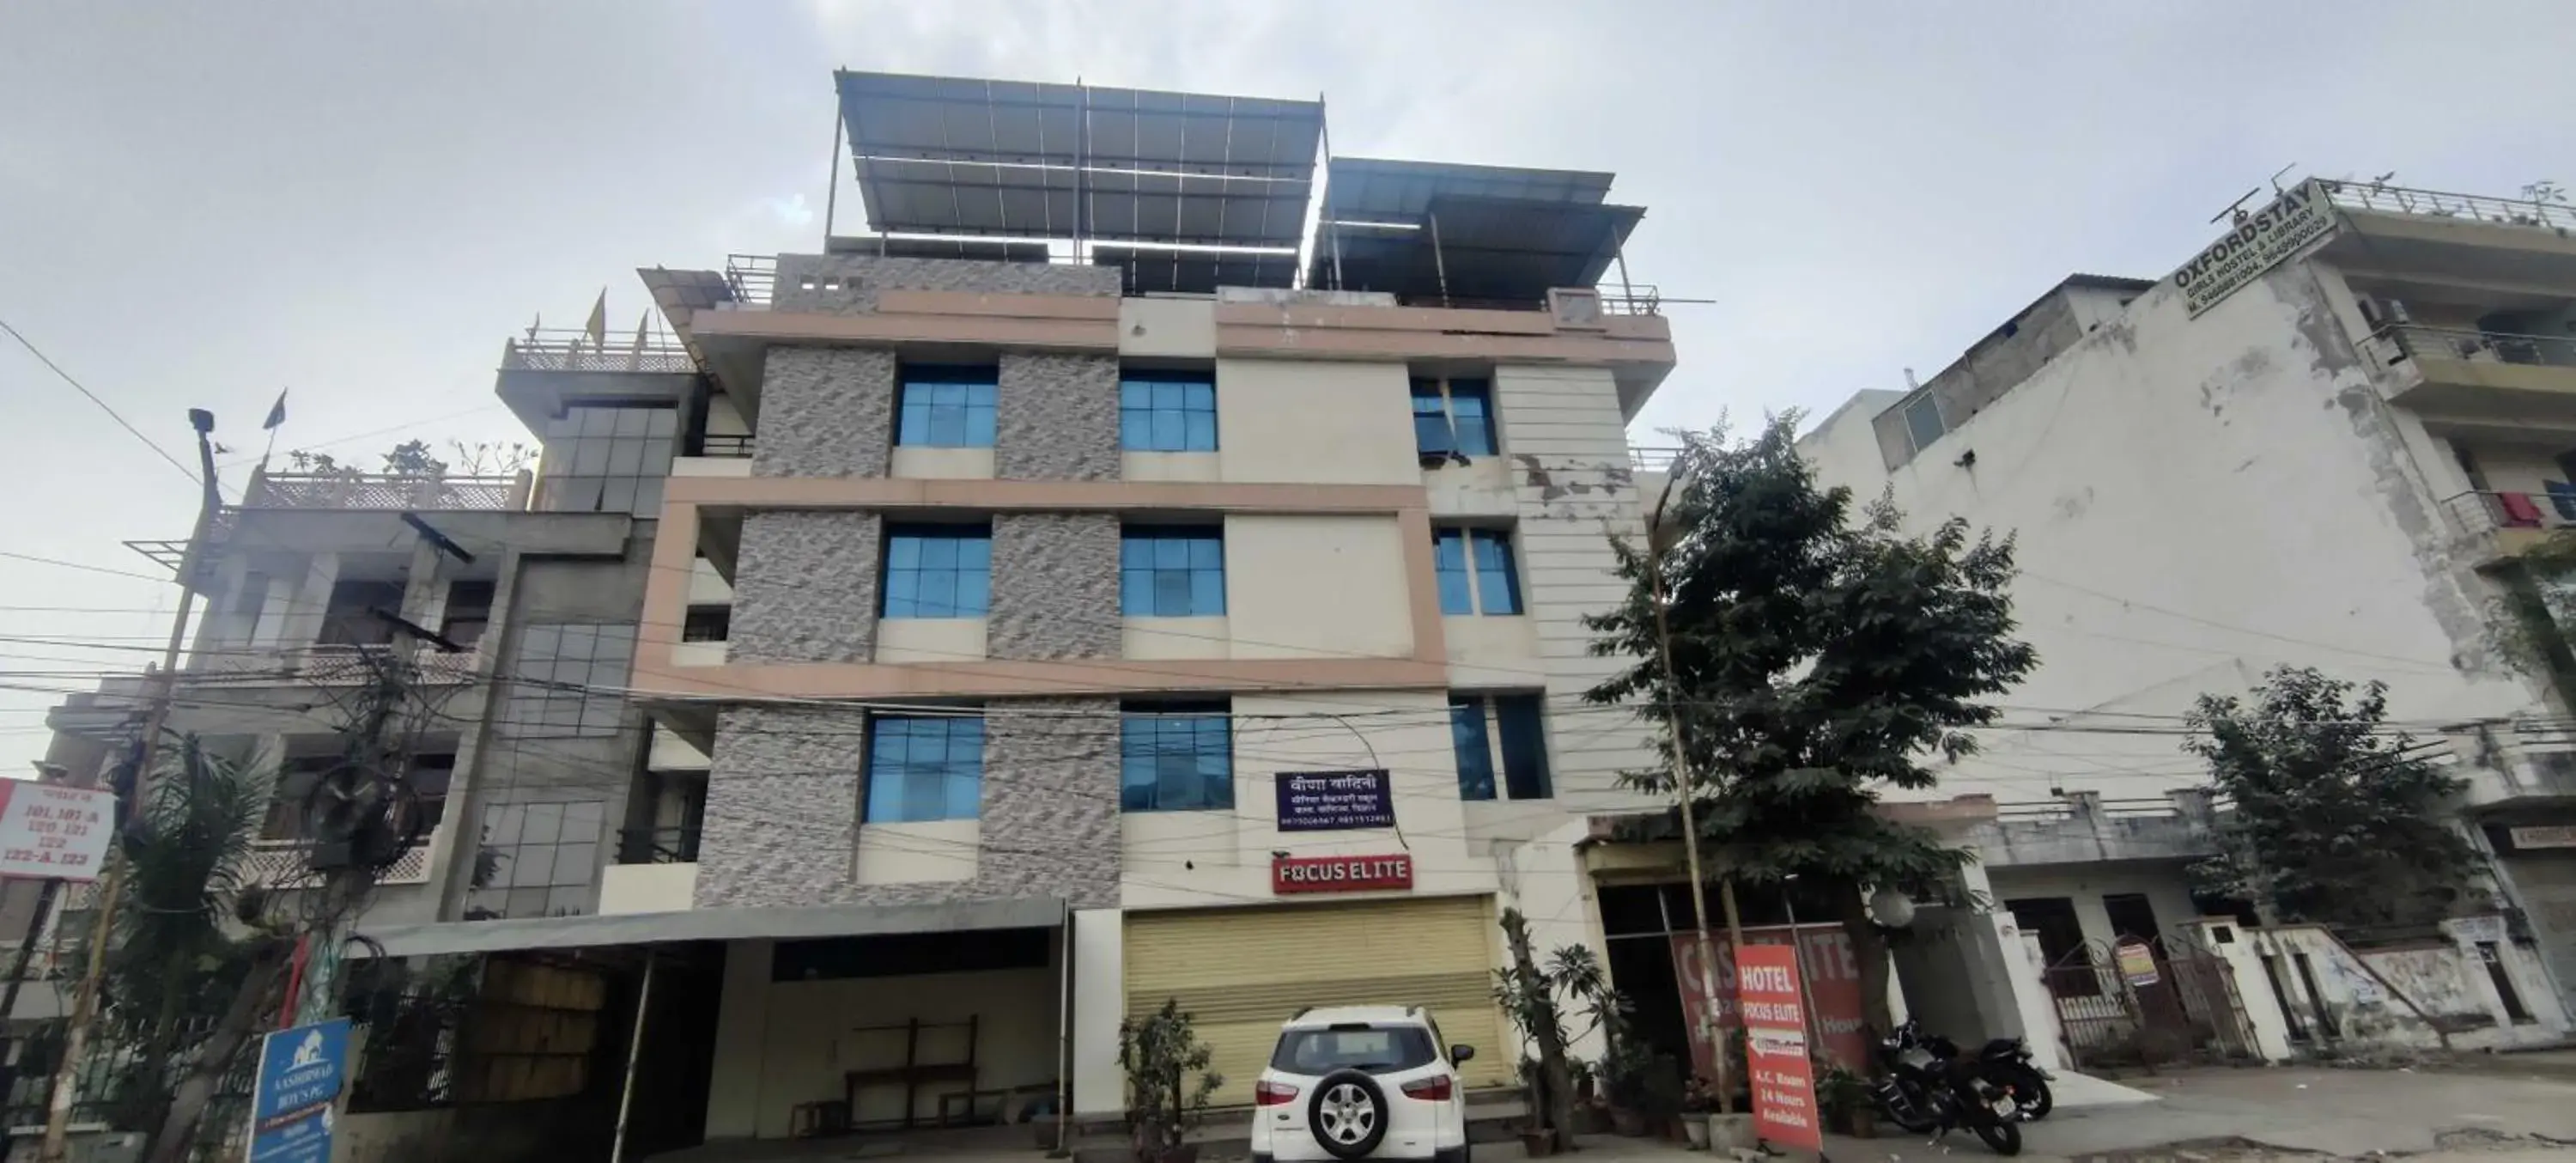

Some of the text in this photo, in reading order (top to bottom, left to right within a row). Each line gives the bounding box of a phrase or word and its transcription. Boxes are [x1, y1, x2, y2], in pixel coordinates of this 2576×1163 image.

[2175, 181, 2312, 289] OXFORDSTAY
[2187, 272, 2215, 299] GIRLS
[2217, 247, 2254, 277] HOSTEL
[2268, 206, 2315, 243] LIBRARY
[1290, 773, 1377, 790] वीणा वादिनी
[1279, 860, 1407, 882] FOCUS ELITE
[1741, 965, 1795, 993] HOTEL
[1743, 1002, 1772, 1021] FOCUS
[1773, 1002, 1801, 1023] ELITE
[1776, 1072, 1806, 1088] Room
[1760, 1087, 1806, 1107] 24 Hours
[1763, 1107, 1808, 1128] Available
